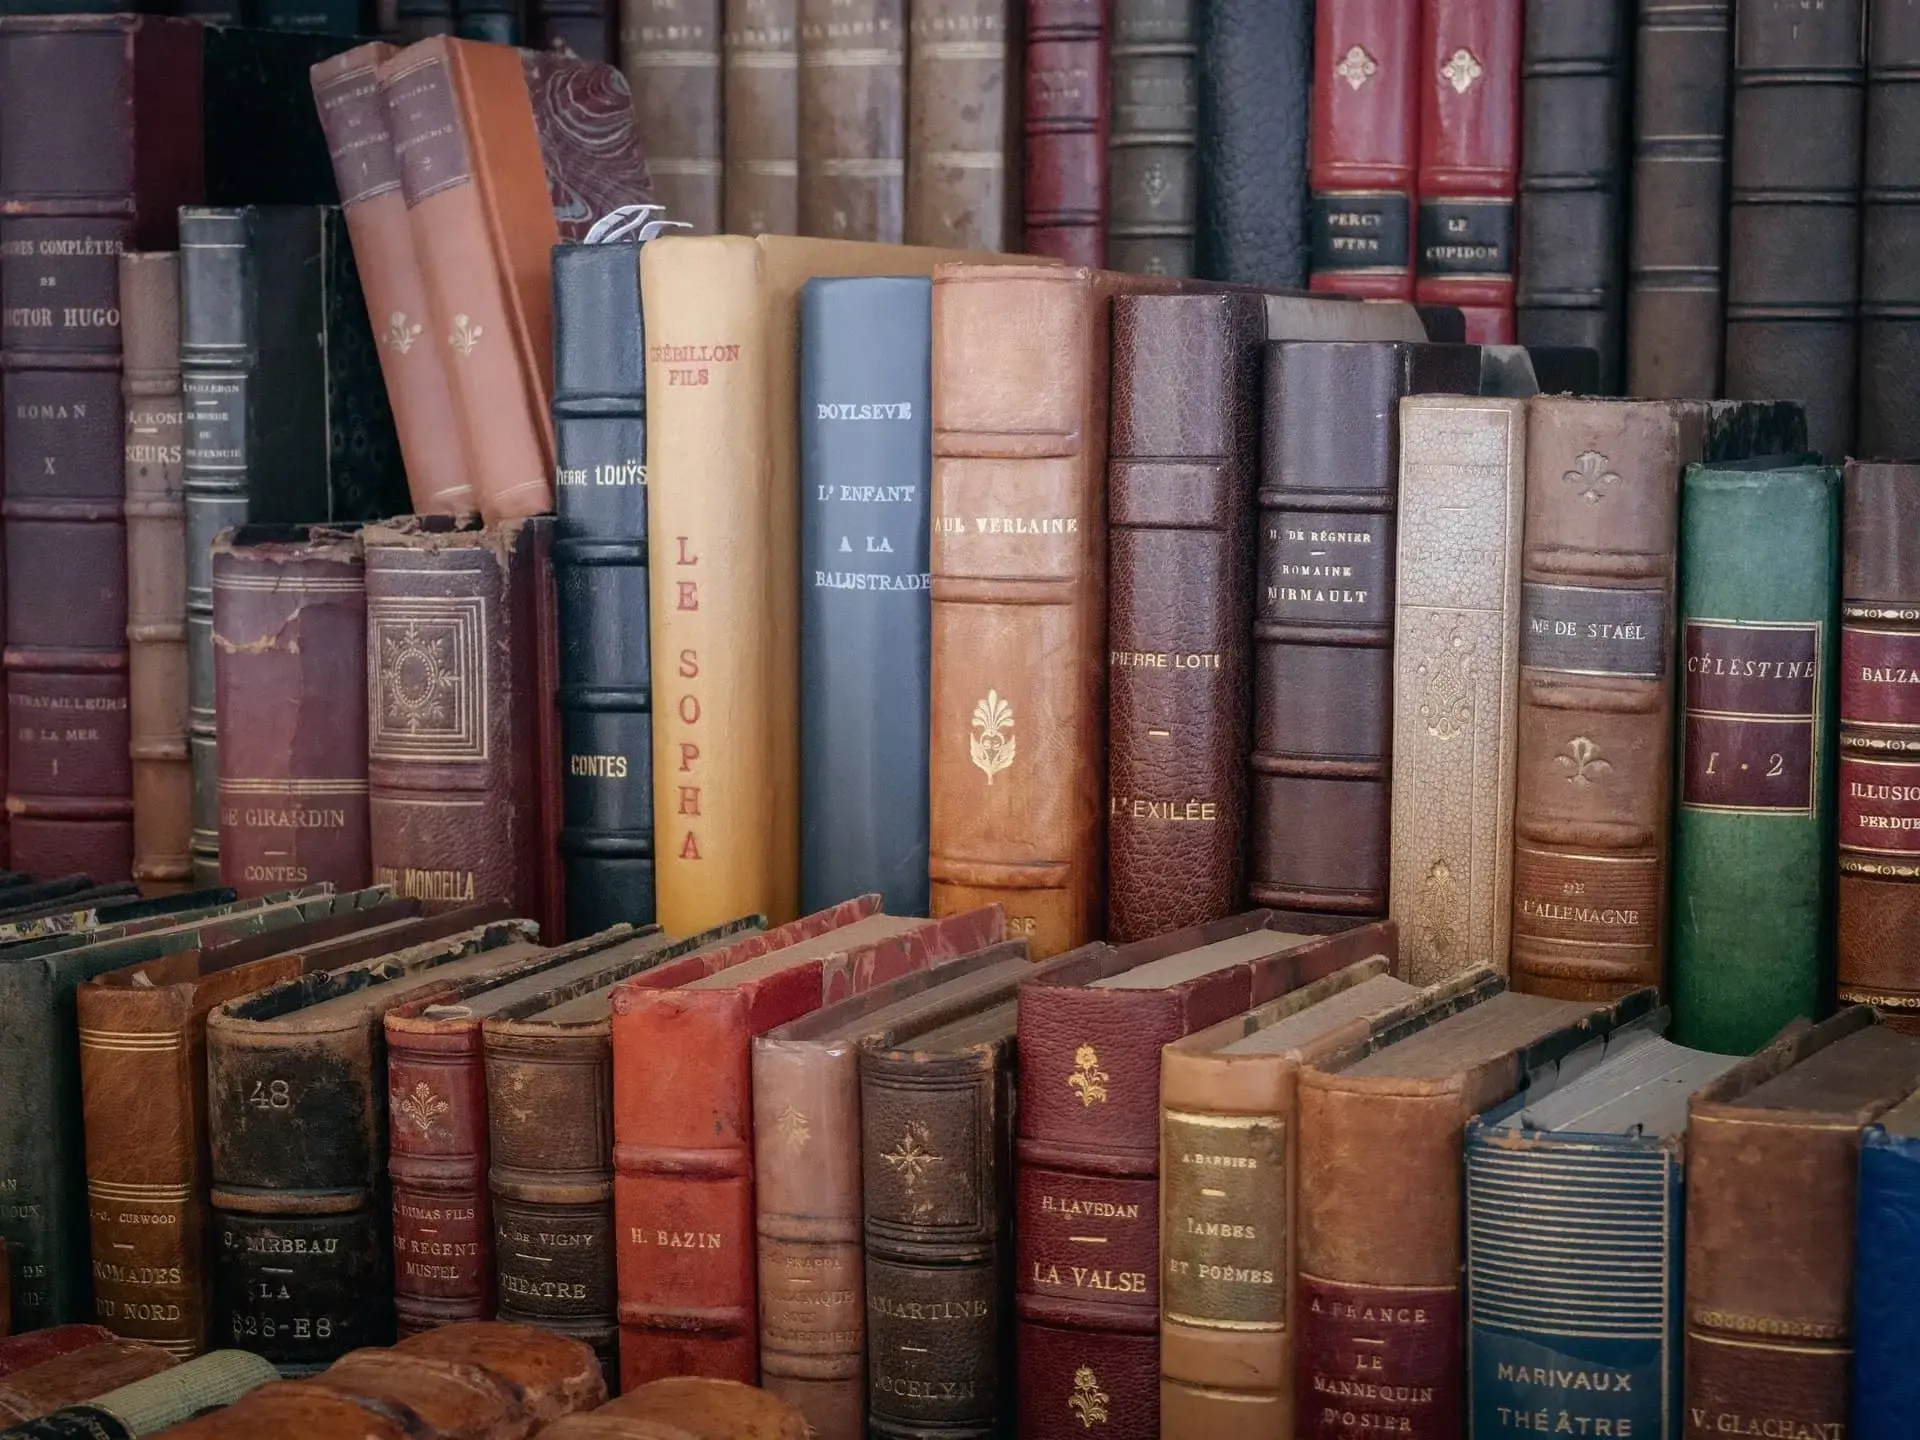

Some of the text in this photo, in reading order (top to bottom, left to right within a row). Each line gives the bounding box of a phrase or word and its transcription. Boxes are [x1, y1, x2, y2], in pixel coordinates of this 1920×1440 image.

[1448, 218, 1468, 232] LE
[63, 307, 120, 327] HUGO
[669, 368, 709, 386] FILS
[17, 404, 87, 420] ROMAN
[44, 456, 56, 475] X
[976, 517, 1078, 534] VERLAINE
[866, 535, 895, 552] LA
[1288, 530, 1304, 541] DE
[1311, 530, 1371, 543] RÉGNIER
[815, 570, 931, 591] BALUSTRADE
[1282, 564, 1353, 577] ROMAINE
[1554, 621, 1577, 636] DE
[1110, 651, 1221, 669] PIERRE LOTI
[1687, 652, 1816, 679] CÉLESTINE
[677, 648, 702, 860] SOPHA
[570, 754, 628, 778] CONTES
[1765, 753, 1784, 777] 2
[246, 808, 345, 829] GIRARDIN
[1111, 796, 1217, 821] L'EXILÉE
[244, 865, 309, 882] CONTES
[405, 867, 475, 901] MONDELLA
[1524, 900, 1640, 925] L'ALLEMAGNE
[250, 1079, 290, 1108] 48
[445, 1208, 475, 1221] FILS
[1041, 1195, 1139, 1218] H. LAVEDAN
[120, 1213, 177, 1225] CURWOOD
[1187, 1217, 1257, 1240] IAMBES
[246, 1235, 340, 1254] MIRBEAU
[538, 1232, 593, 1247] VIGNY
[657, 1229, 722, 1249] BAZIN
[1032, 1260, 1147, 1293] LA VALSE
[1170, 1258, 1190, 1275] ET
[259, 1283, 291, 1299] LA
[122, 1302, 181, 1321] NORD
[1331, 1302, 1427, 1324] FRANCE
[1356, 1354, 1383, 1370] LE
[1496, 1361, 1633, 1393] MARIVAUX
[1313, 1375, 1435, 1403] MANNEQUIN
[1323, 1407, 1413, 1433] D'OSIER
[1496, 1407, 1633, 1438] THÉÂTRE
[1691, 1407, 1845, 1440] V. GLACHANT
